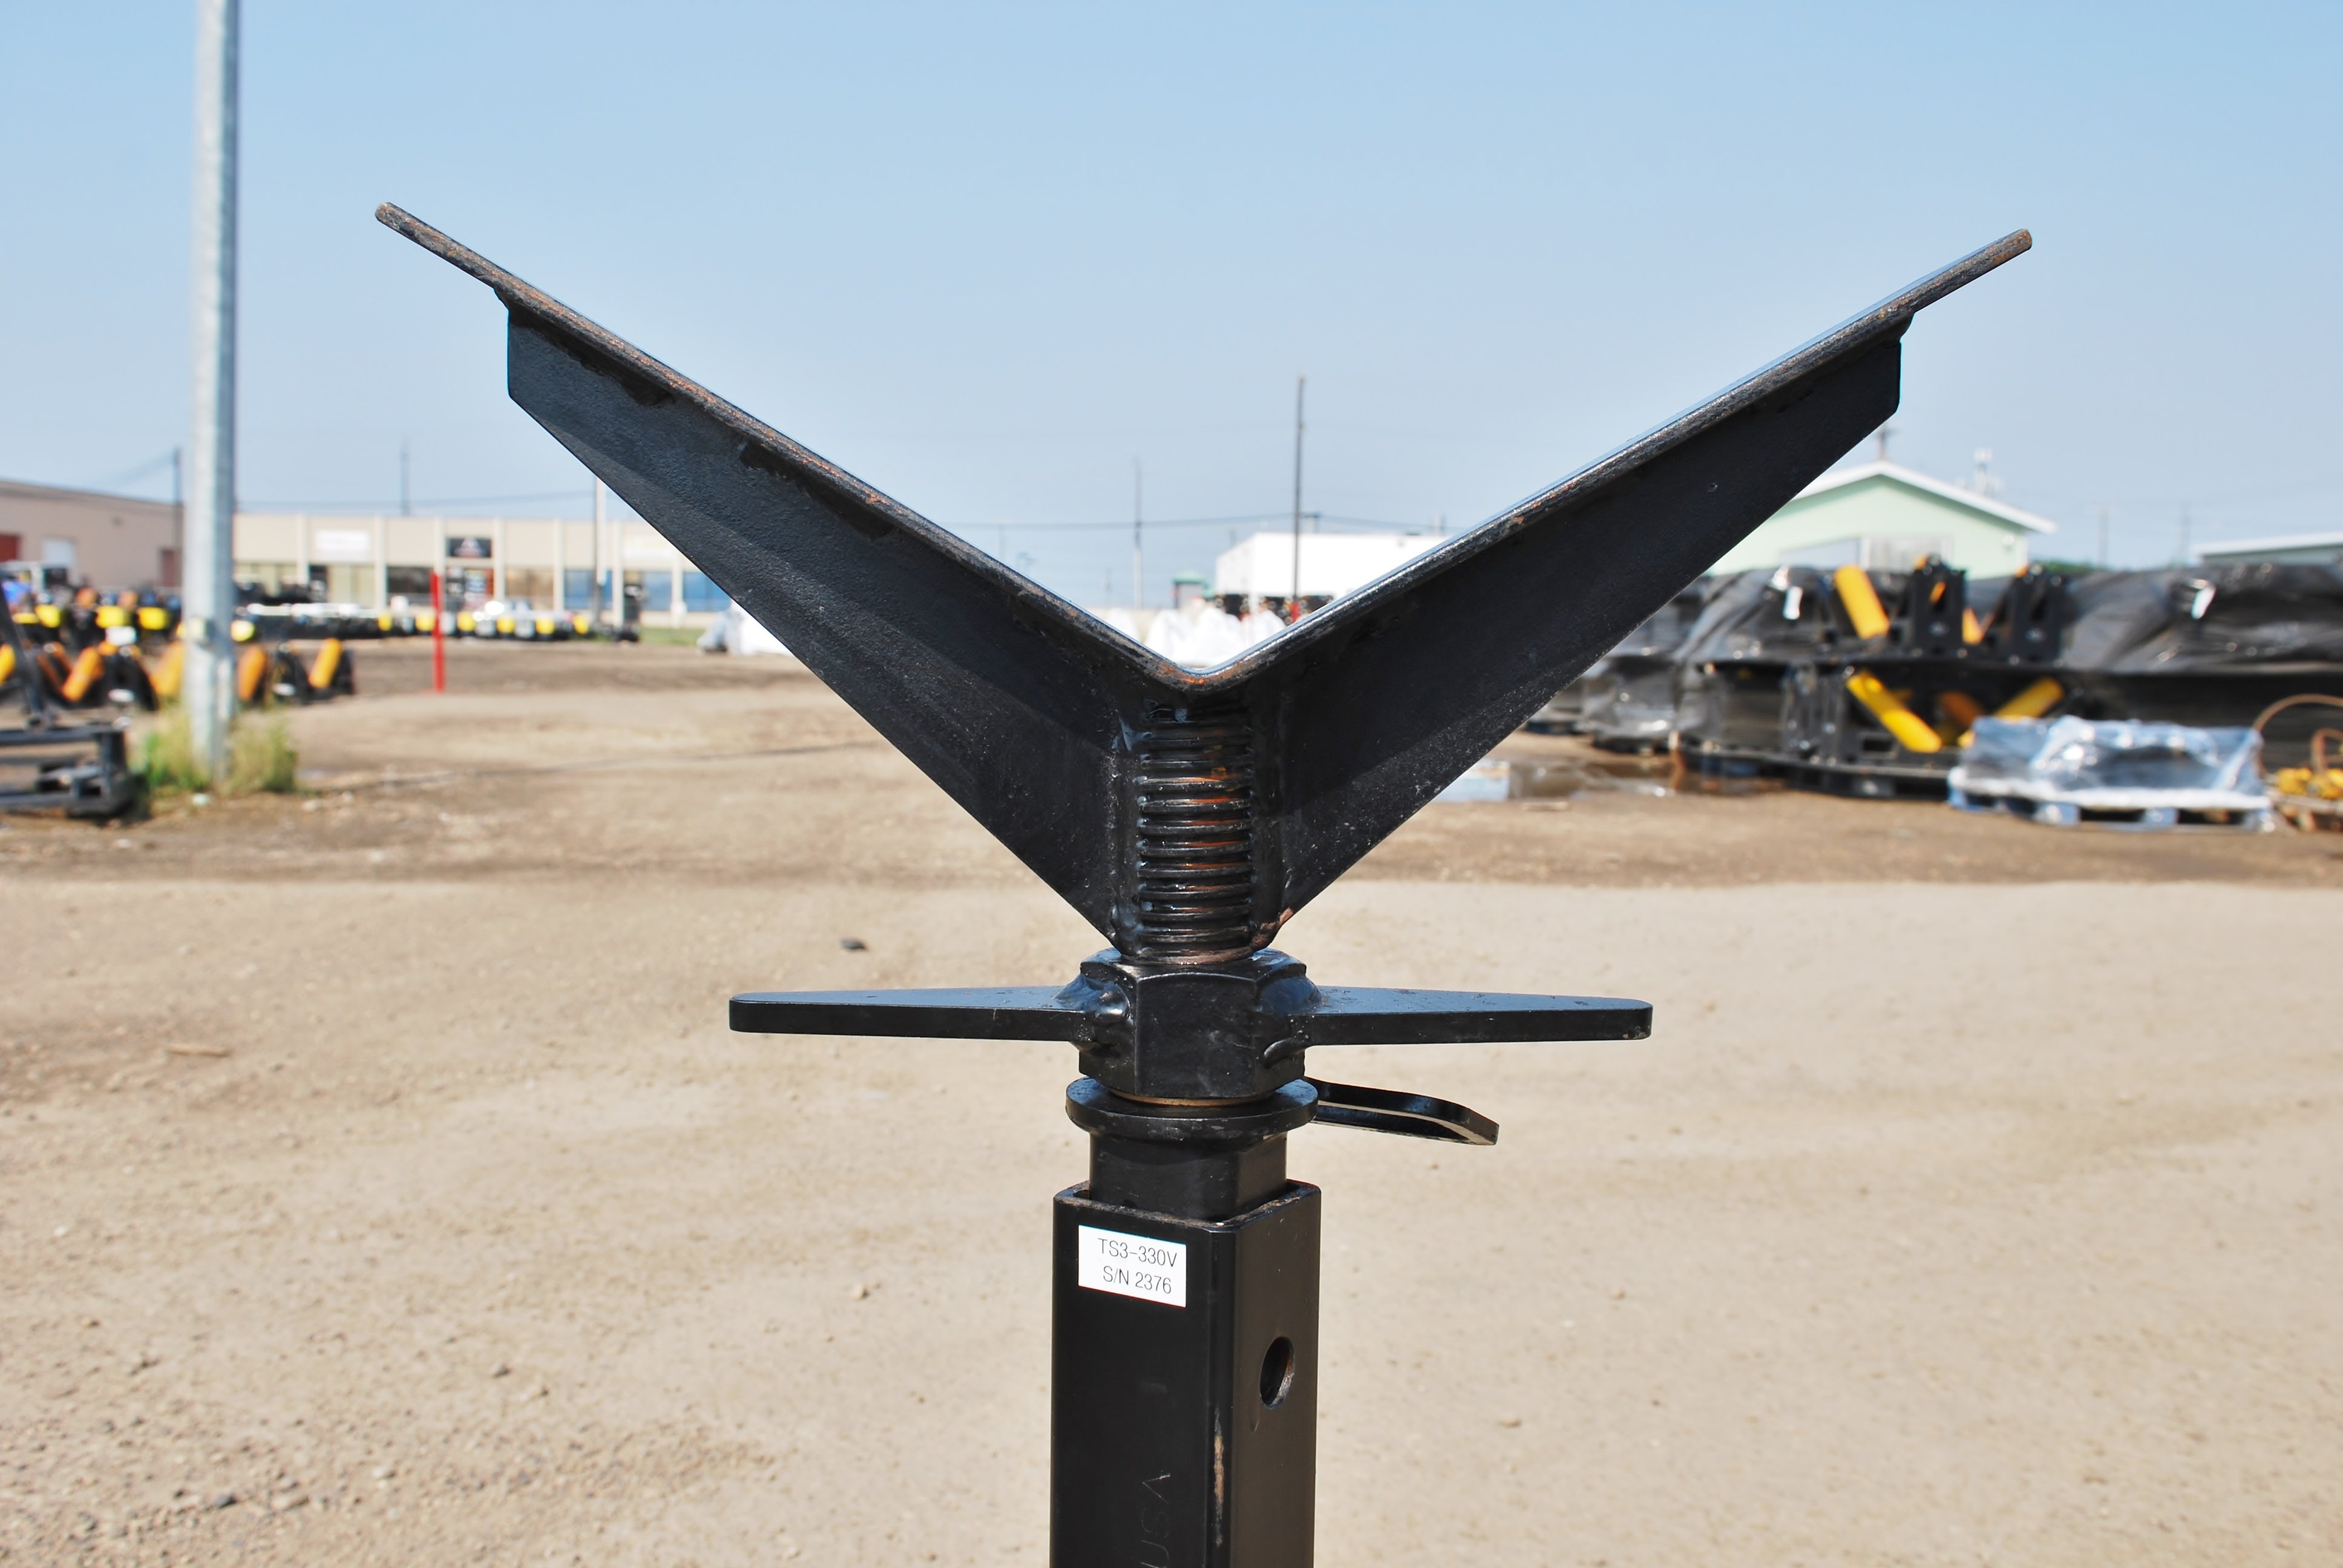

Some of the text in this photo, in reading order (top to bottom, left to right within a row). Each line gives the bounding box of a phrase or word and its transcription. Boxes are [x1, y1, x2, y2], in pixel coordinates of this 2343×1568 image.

[1098, 1238, 1177, 1267] TS3-330V
[1103, 1266, 1172, 1294] S/N 2376
[1140, 1472, 1172, 1568] USA
